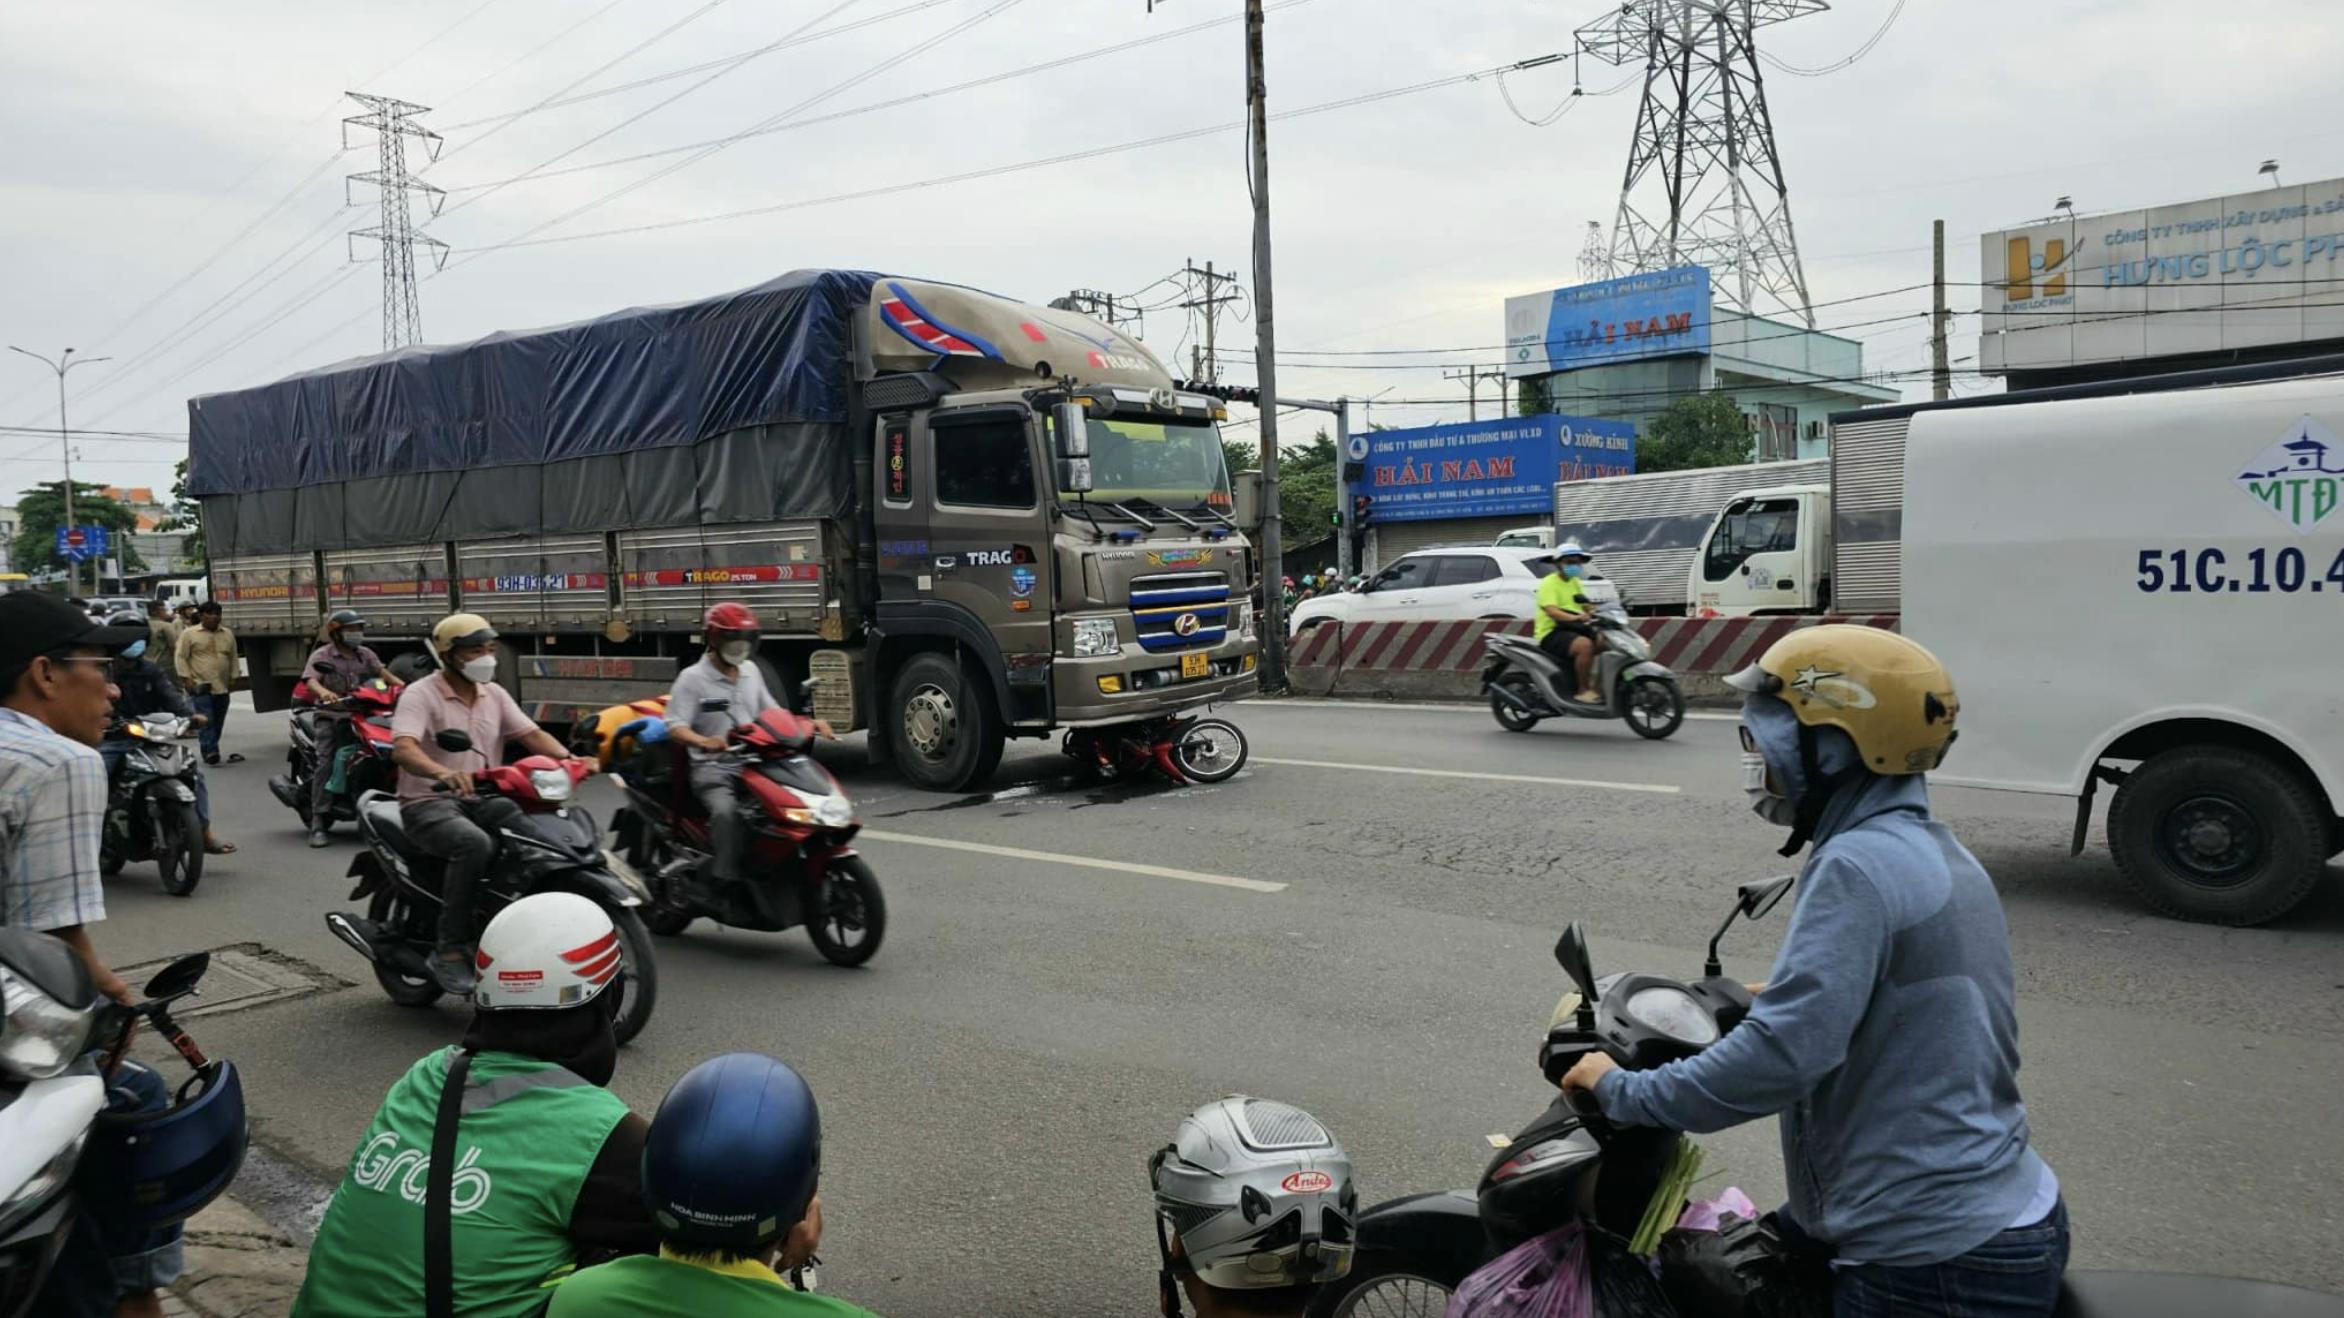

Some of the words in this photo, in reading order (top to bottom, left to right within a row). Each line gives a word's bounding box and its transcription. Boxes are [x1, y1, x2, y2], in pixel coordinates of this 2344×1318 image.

[2104, 229, 2148, 246] CÔNG
[2152, 225, 2172, 239] TY
[2176, 217, 2220, 236] TNHH
[2222, 210, 2256, 229] XÂY
[2259, 205, 2308, 223] DỰNG
[2103, 252, 2210, 288] HƯNG
[2218, 236, 2293, 278] LỘC
[1623, 312, 1692, 341] NAM
[1374, 440, 1394, 453] CÔNG
[1396, 441, 1406, 452] TY
[1408, 439, 1428, 450] TNHH
[1375, 455, 1433, 487] HẢI
[1441, 456, 1515, 481] NAM
[2249, 476, 2344, 526] MTĐ
[966, 549, 1026, 566] TRAGO
[240, 585, 289, 598] HYUNDAI
[685, 570, 730, 583] TRAGO
[354, 1131, 491, 1214] Grab
